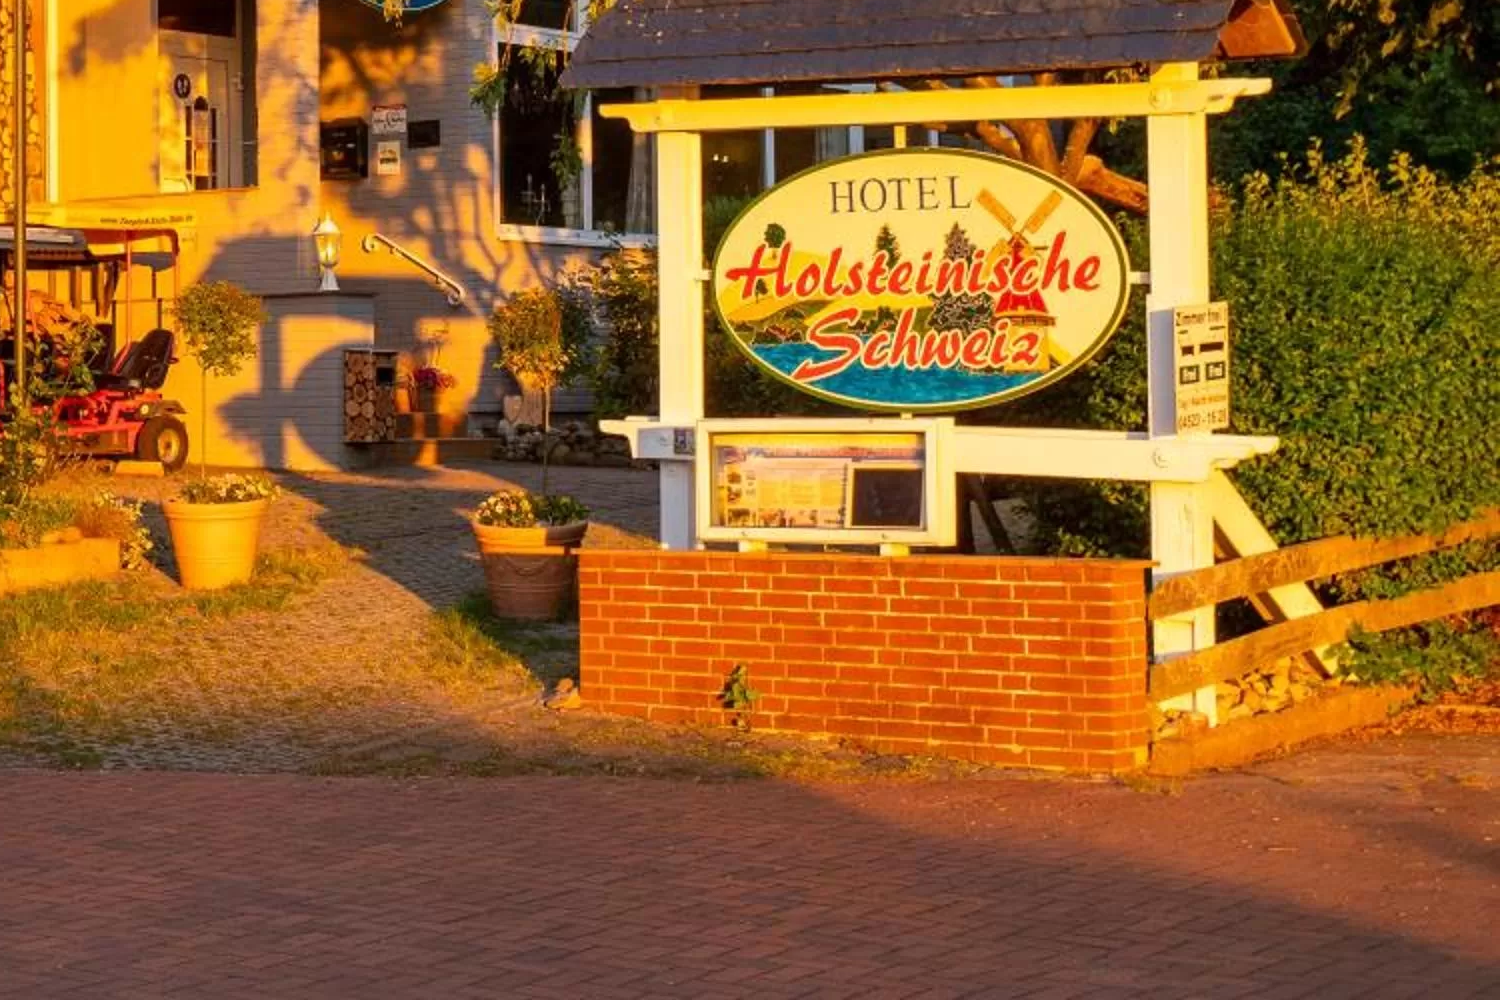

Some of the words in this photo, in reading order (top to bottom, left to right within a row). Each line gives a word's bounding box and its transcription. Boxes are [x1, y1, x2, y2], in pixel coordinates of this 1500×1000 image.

[828, 175, 972, 214] HOTEL
[725, 230, 1101, 300] Holsteinische
[791, 307, 1040, 381] Schweiz
